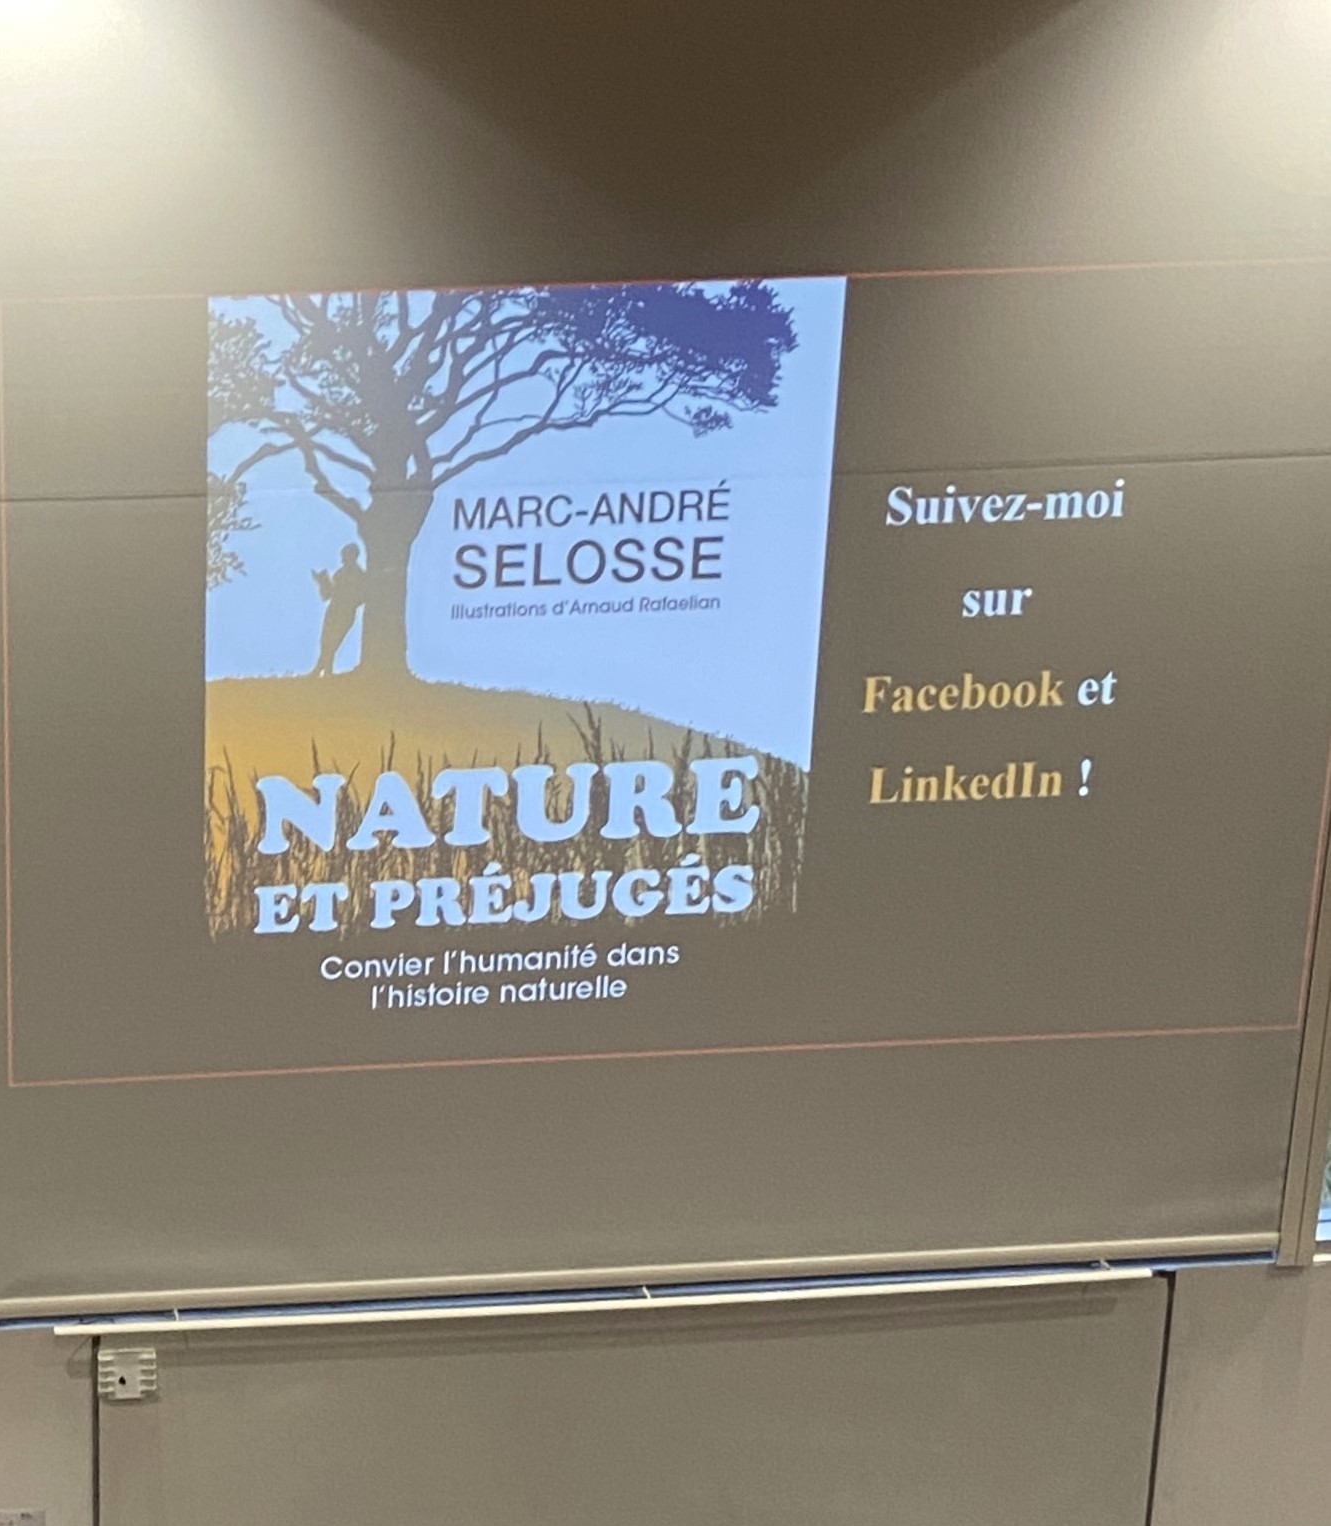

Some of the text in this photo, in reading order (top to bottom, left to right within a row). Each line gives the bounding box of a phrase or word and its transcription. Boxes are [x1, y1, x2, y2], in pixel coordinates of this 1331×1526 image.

[452, 480, 731, 530] MARC-ANDRÉ
[885, 479, 1125, 527] Suivez-moi
[453, 535, 725, 590] SELOSSE
[450, 594, 721, 621] Illustrations d'Arnaud Rafaelian
[962, 586, 1033, 618] sur
[861, 669, 1117, 713] Facebook et
[869, 761, 1063, 804] LinkedIn
[255, 755, 760, 855] NATURE
[253, 853, 755, 934] ET PRÉJUGÉS
[320, 940, 680, 981] Convier l'humanité dans
[371, 974, 627, 1010] l'histoire naturelle
